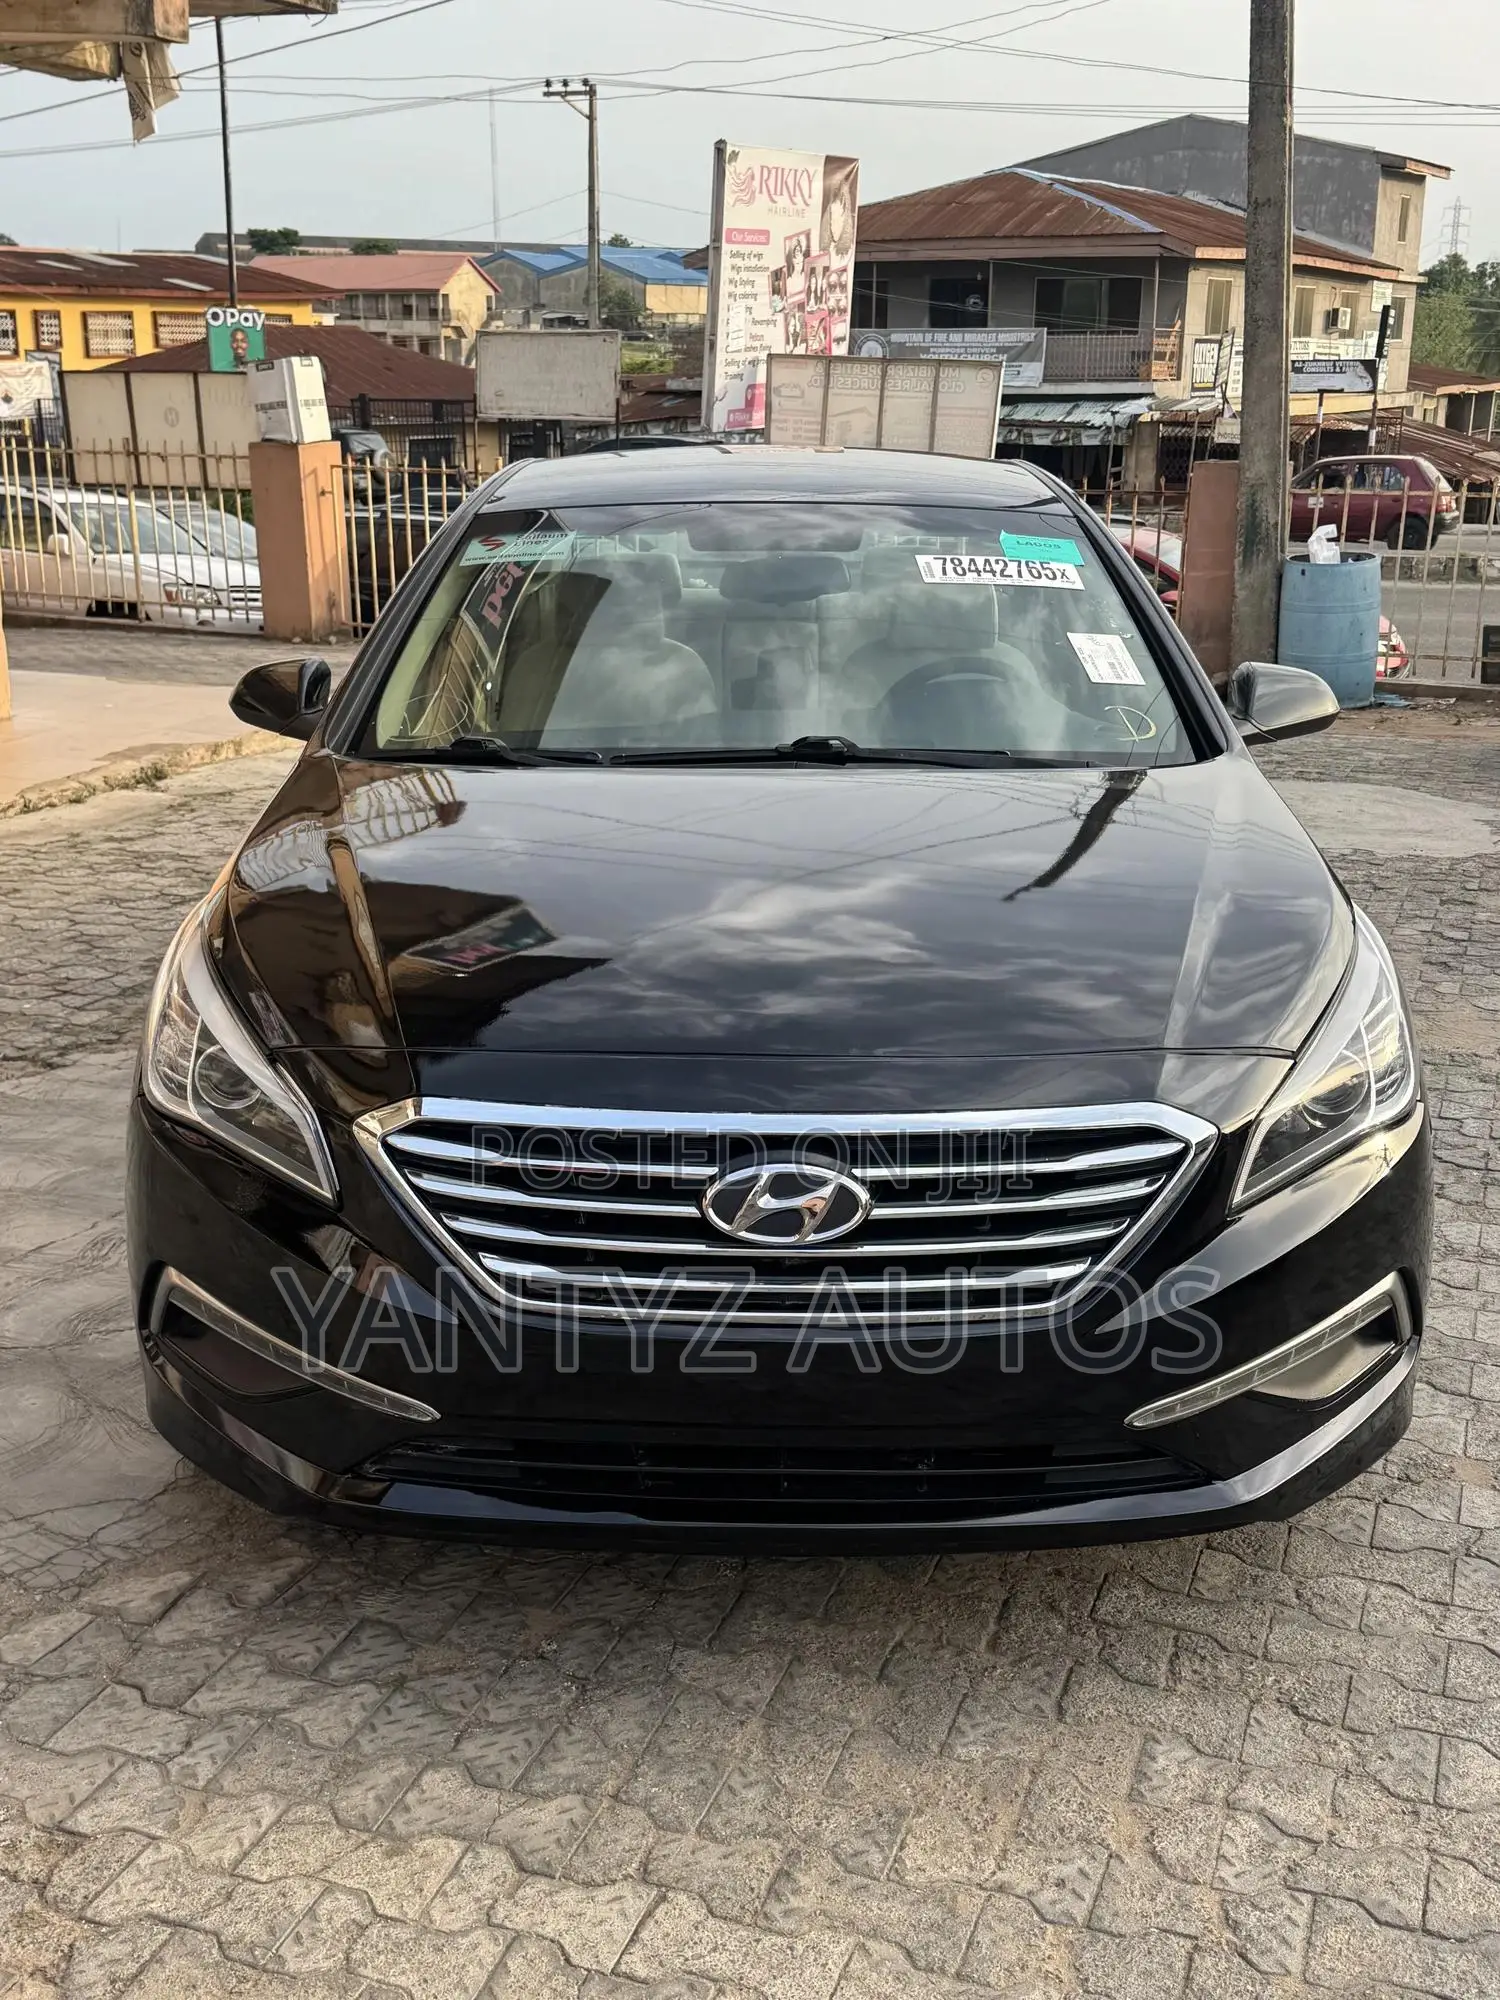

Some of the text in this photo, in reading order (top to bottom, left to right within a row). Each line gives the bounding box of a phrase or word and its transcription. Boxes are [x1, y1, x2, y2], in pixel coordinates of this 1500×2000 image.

[758, 165, 818, 207] RIKKY
[767, 206, 806, 218] HAIRLINE
[729, 250, 745, 261] Selling
[746, 250, 753, 261] of
[1016, 540, 1061, 549] LAGOS
